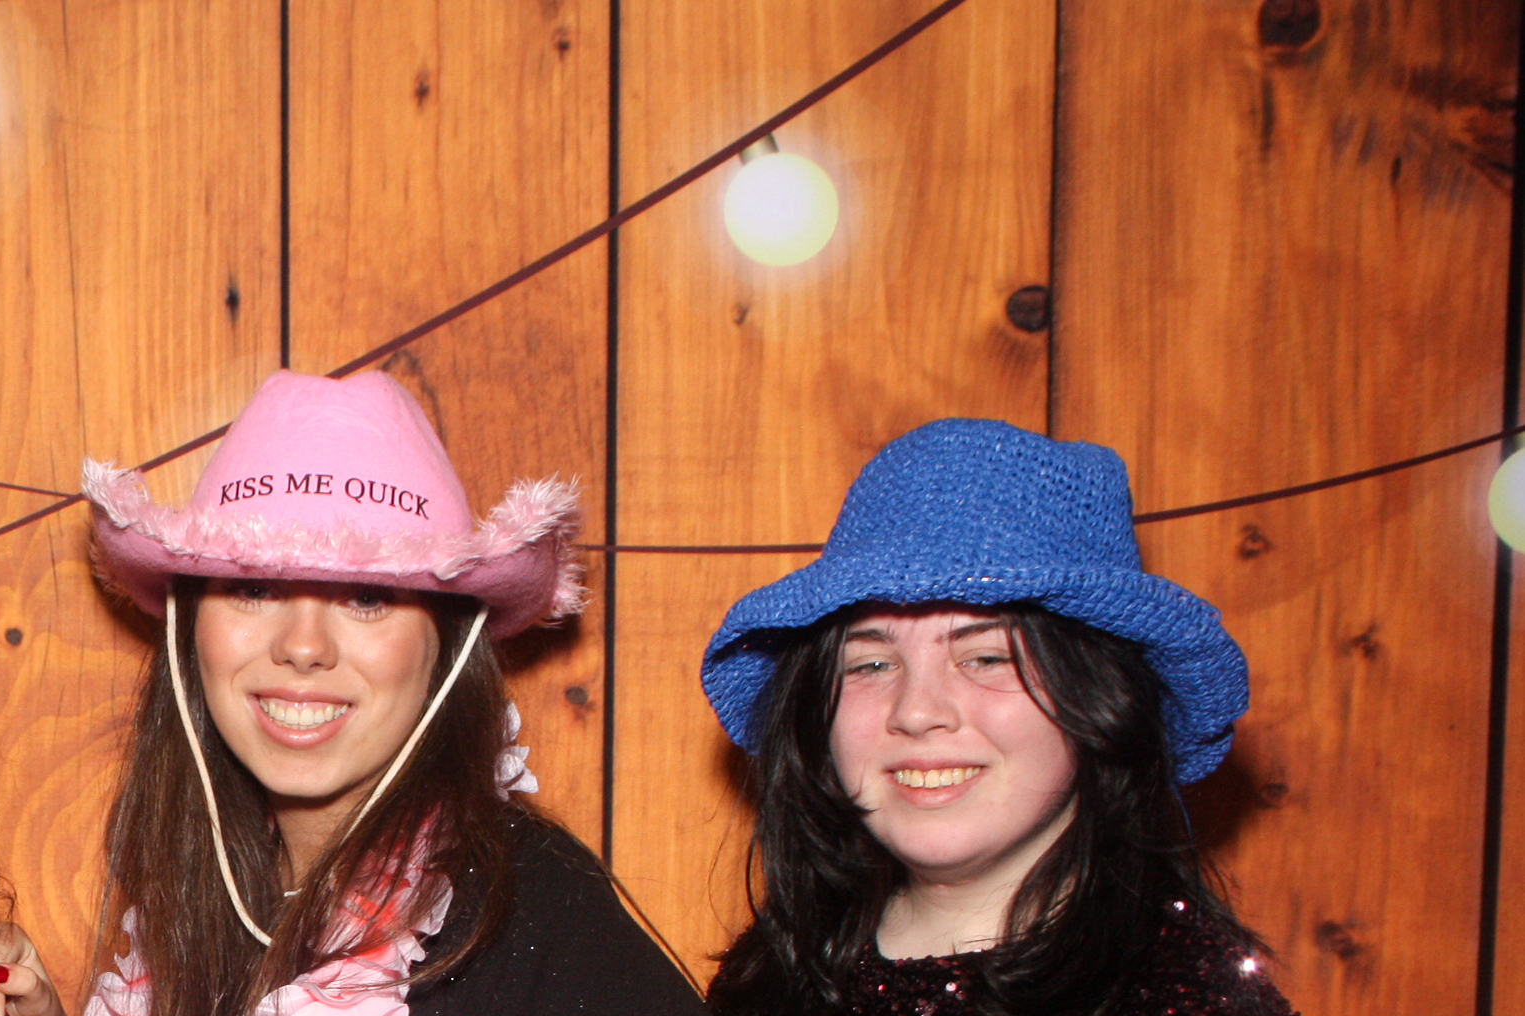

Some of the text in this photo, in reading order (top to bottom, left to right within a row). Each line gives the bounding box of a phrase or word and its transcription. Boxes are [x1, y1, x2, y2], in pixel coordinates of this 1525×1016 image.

[219, 473, 430, 520] KISS ME QUICK
